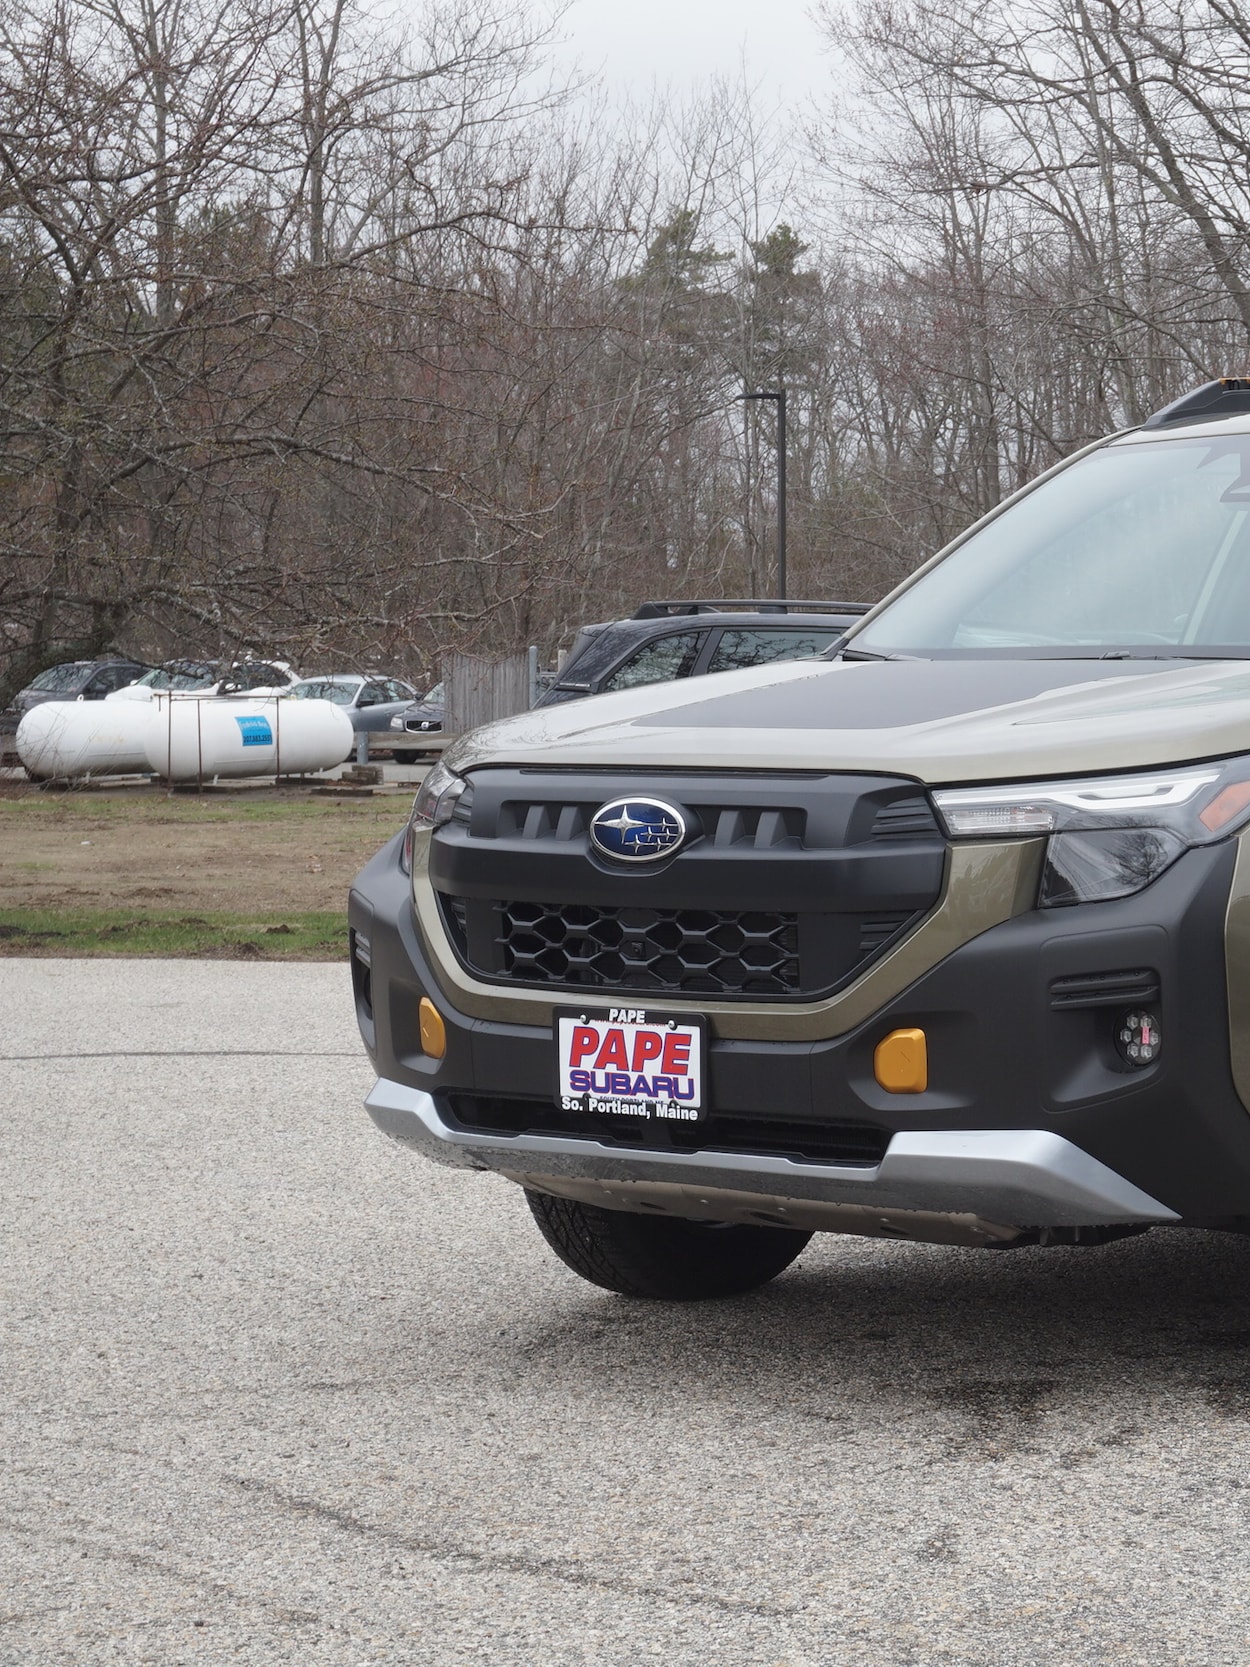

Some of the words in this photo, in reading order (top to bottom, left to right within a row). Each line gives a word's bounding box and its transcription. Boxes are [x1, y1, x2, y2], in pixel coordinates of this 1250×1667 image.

[608, 1008, 646, 1024] PAPE
[569, 1026, 692, 1075] PAPE
[569, 1070, 695, 1100] SUBARU
[561, 1096, 584, 1111] So.
[588, 1098, 651, 1119] Portland,
[656, 1104, 699, 1121] Maine
